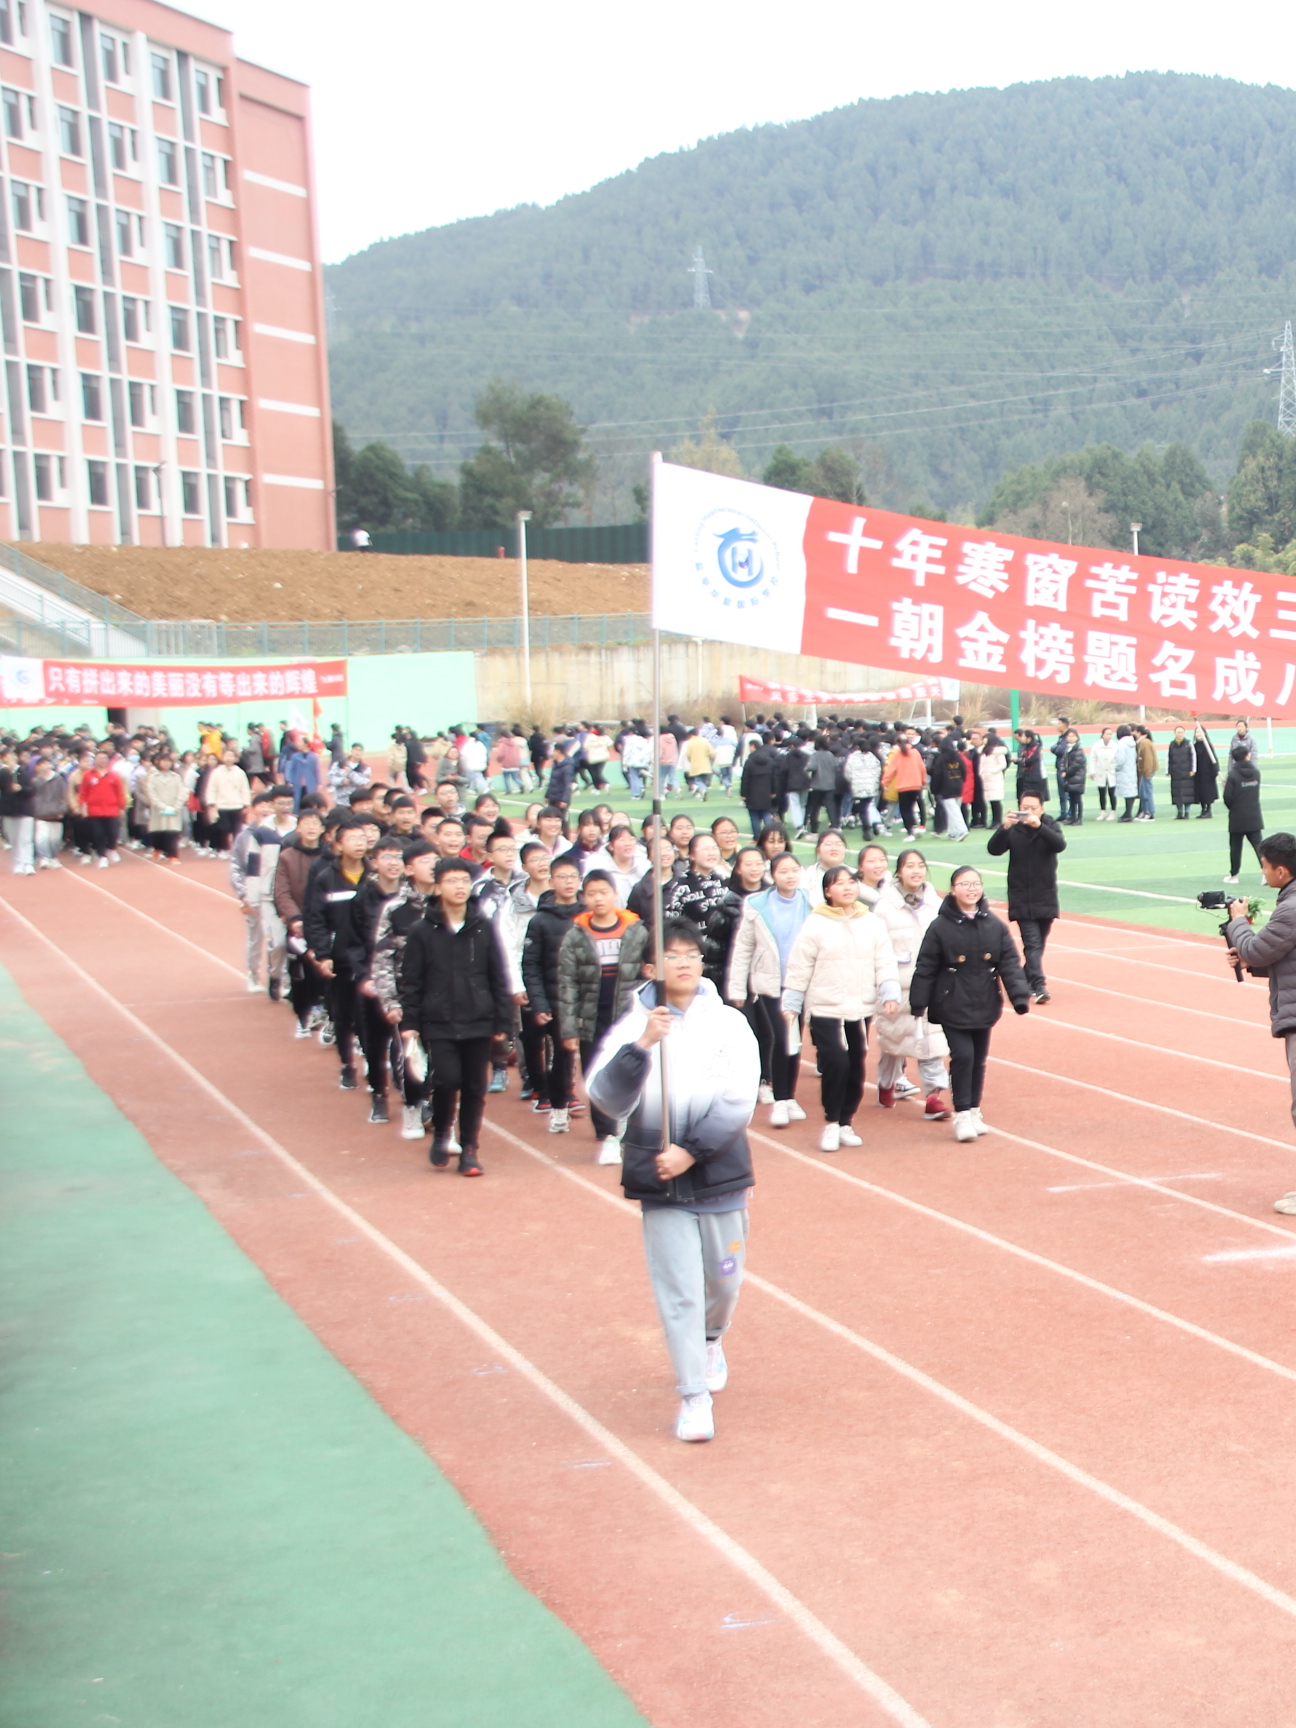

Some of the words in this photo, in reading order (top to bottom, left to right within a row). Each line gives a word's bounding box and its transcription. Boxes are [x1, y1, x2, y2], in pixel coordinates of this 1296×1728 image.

[49, 666, 318, 699] 只有拼出来的美丽没有等出来的辉煌
